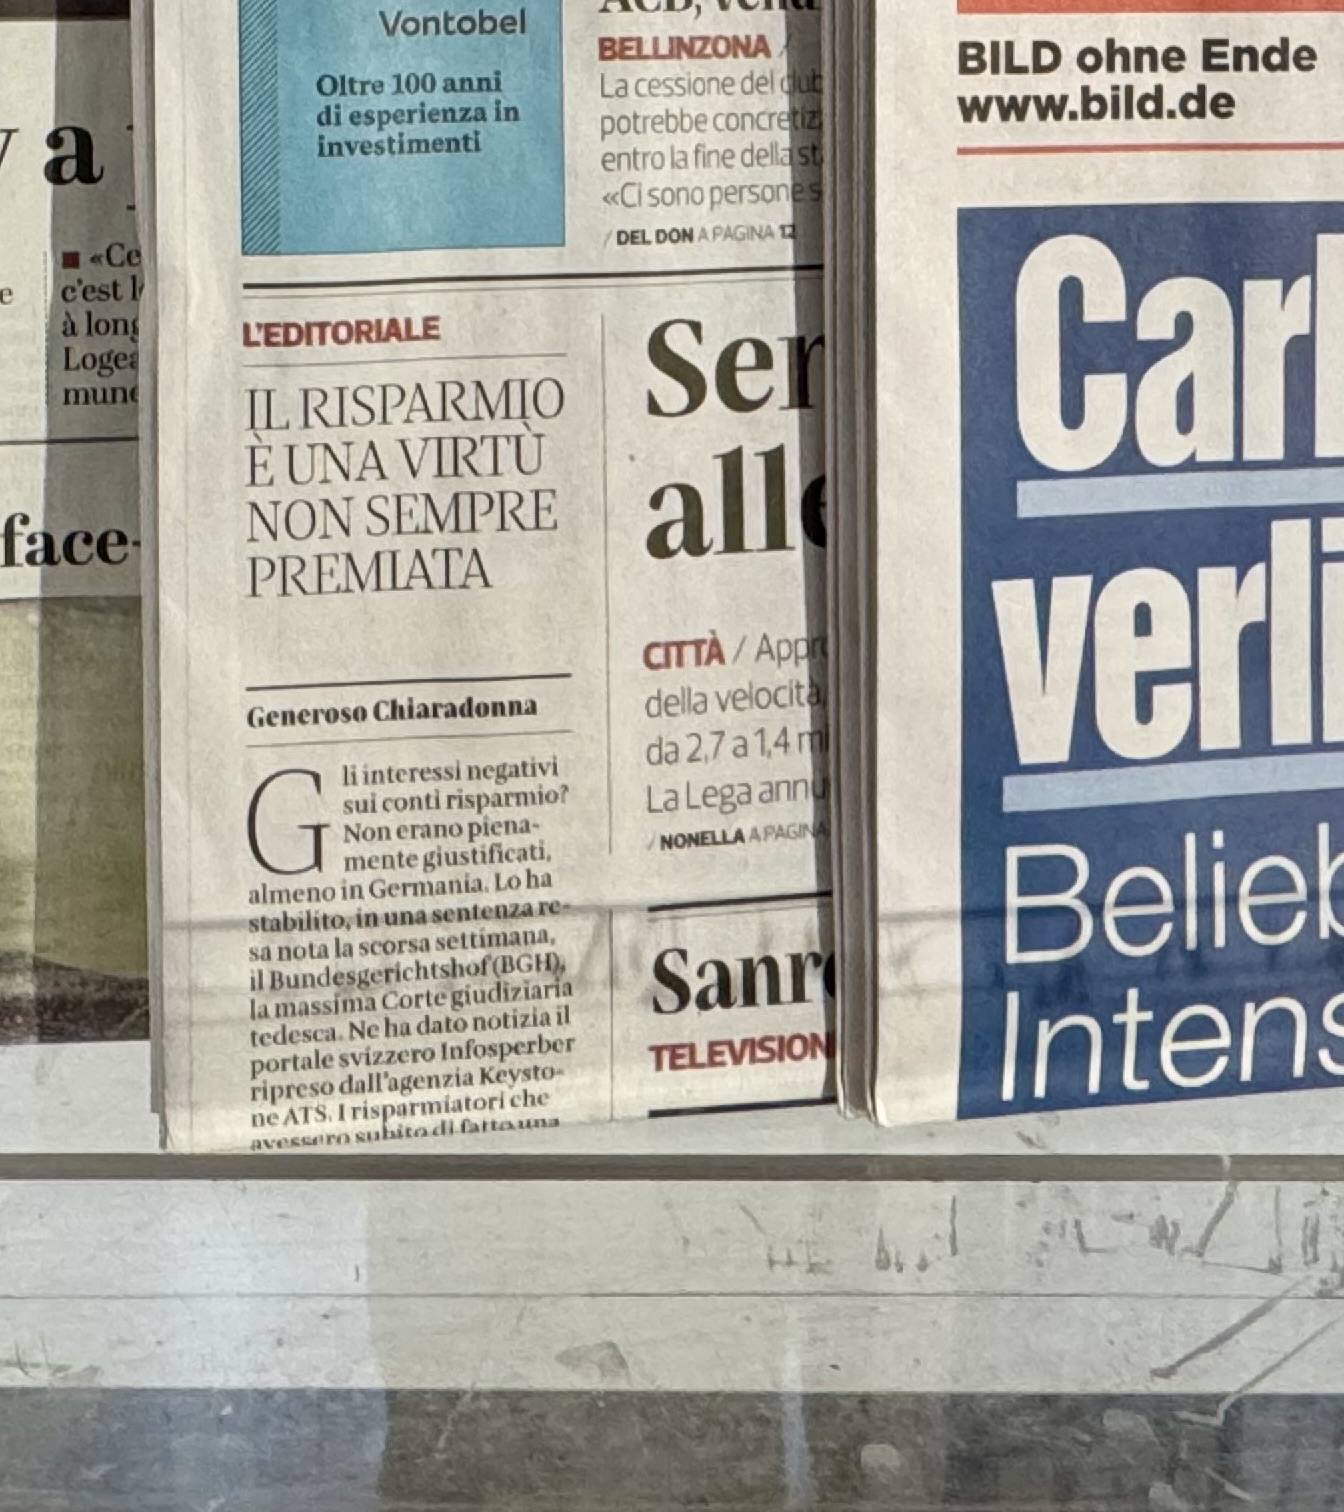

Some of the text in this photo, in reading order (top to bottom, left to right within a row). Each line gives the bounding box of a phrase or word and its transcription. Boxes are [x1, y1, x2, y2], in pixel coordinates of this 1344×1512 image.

[378, 7, 526, 37] Vontobel
[598, 34, 772, 61] BELLINZONA
[958, 36, 1318, 75] BILD ohne Ende
[316, 70, 503, 97] Oltre 100 anni
[600, 71, 736, 99] La cessione
[349, 101, 488, 133] esperienza
[957, 83, 1236, 123] www.bild.de
[43, 126, 104, 186] a
[317, 129, 482, 158] investimenti
[616, 227, 694, 246] DEL DON
[243, 315, 441, 348] L'EDITORIALE
[248, 377, 565, 432] IL RISPARMIO
[245, 420, 546, 487] È UNA VIRTÙ
[247, 488, 558, 543] NON SEMPRE
[248, 547, 493, 598] PREMIATA
[642, 629, 726, 671] CITTÀ
[247, 696, 537, 729] Generoso Chiaradonna
[363, 754, 559, 785] interessi negativi
[446, 783, 569, 815] risparmio?
[660, 828, 746, 851] NONELLA
[422, 839, 551, 874] giustificati,
[368, 872, 489, 899] Germania.
